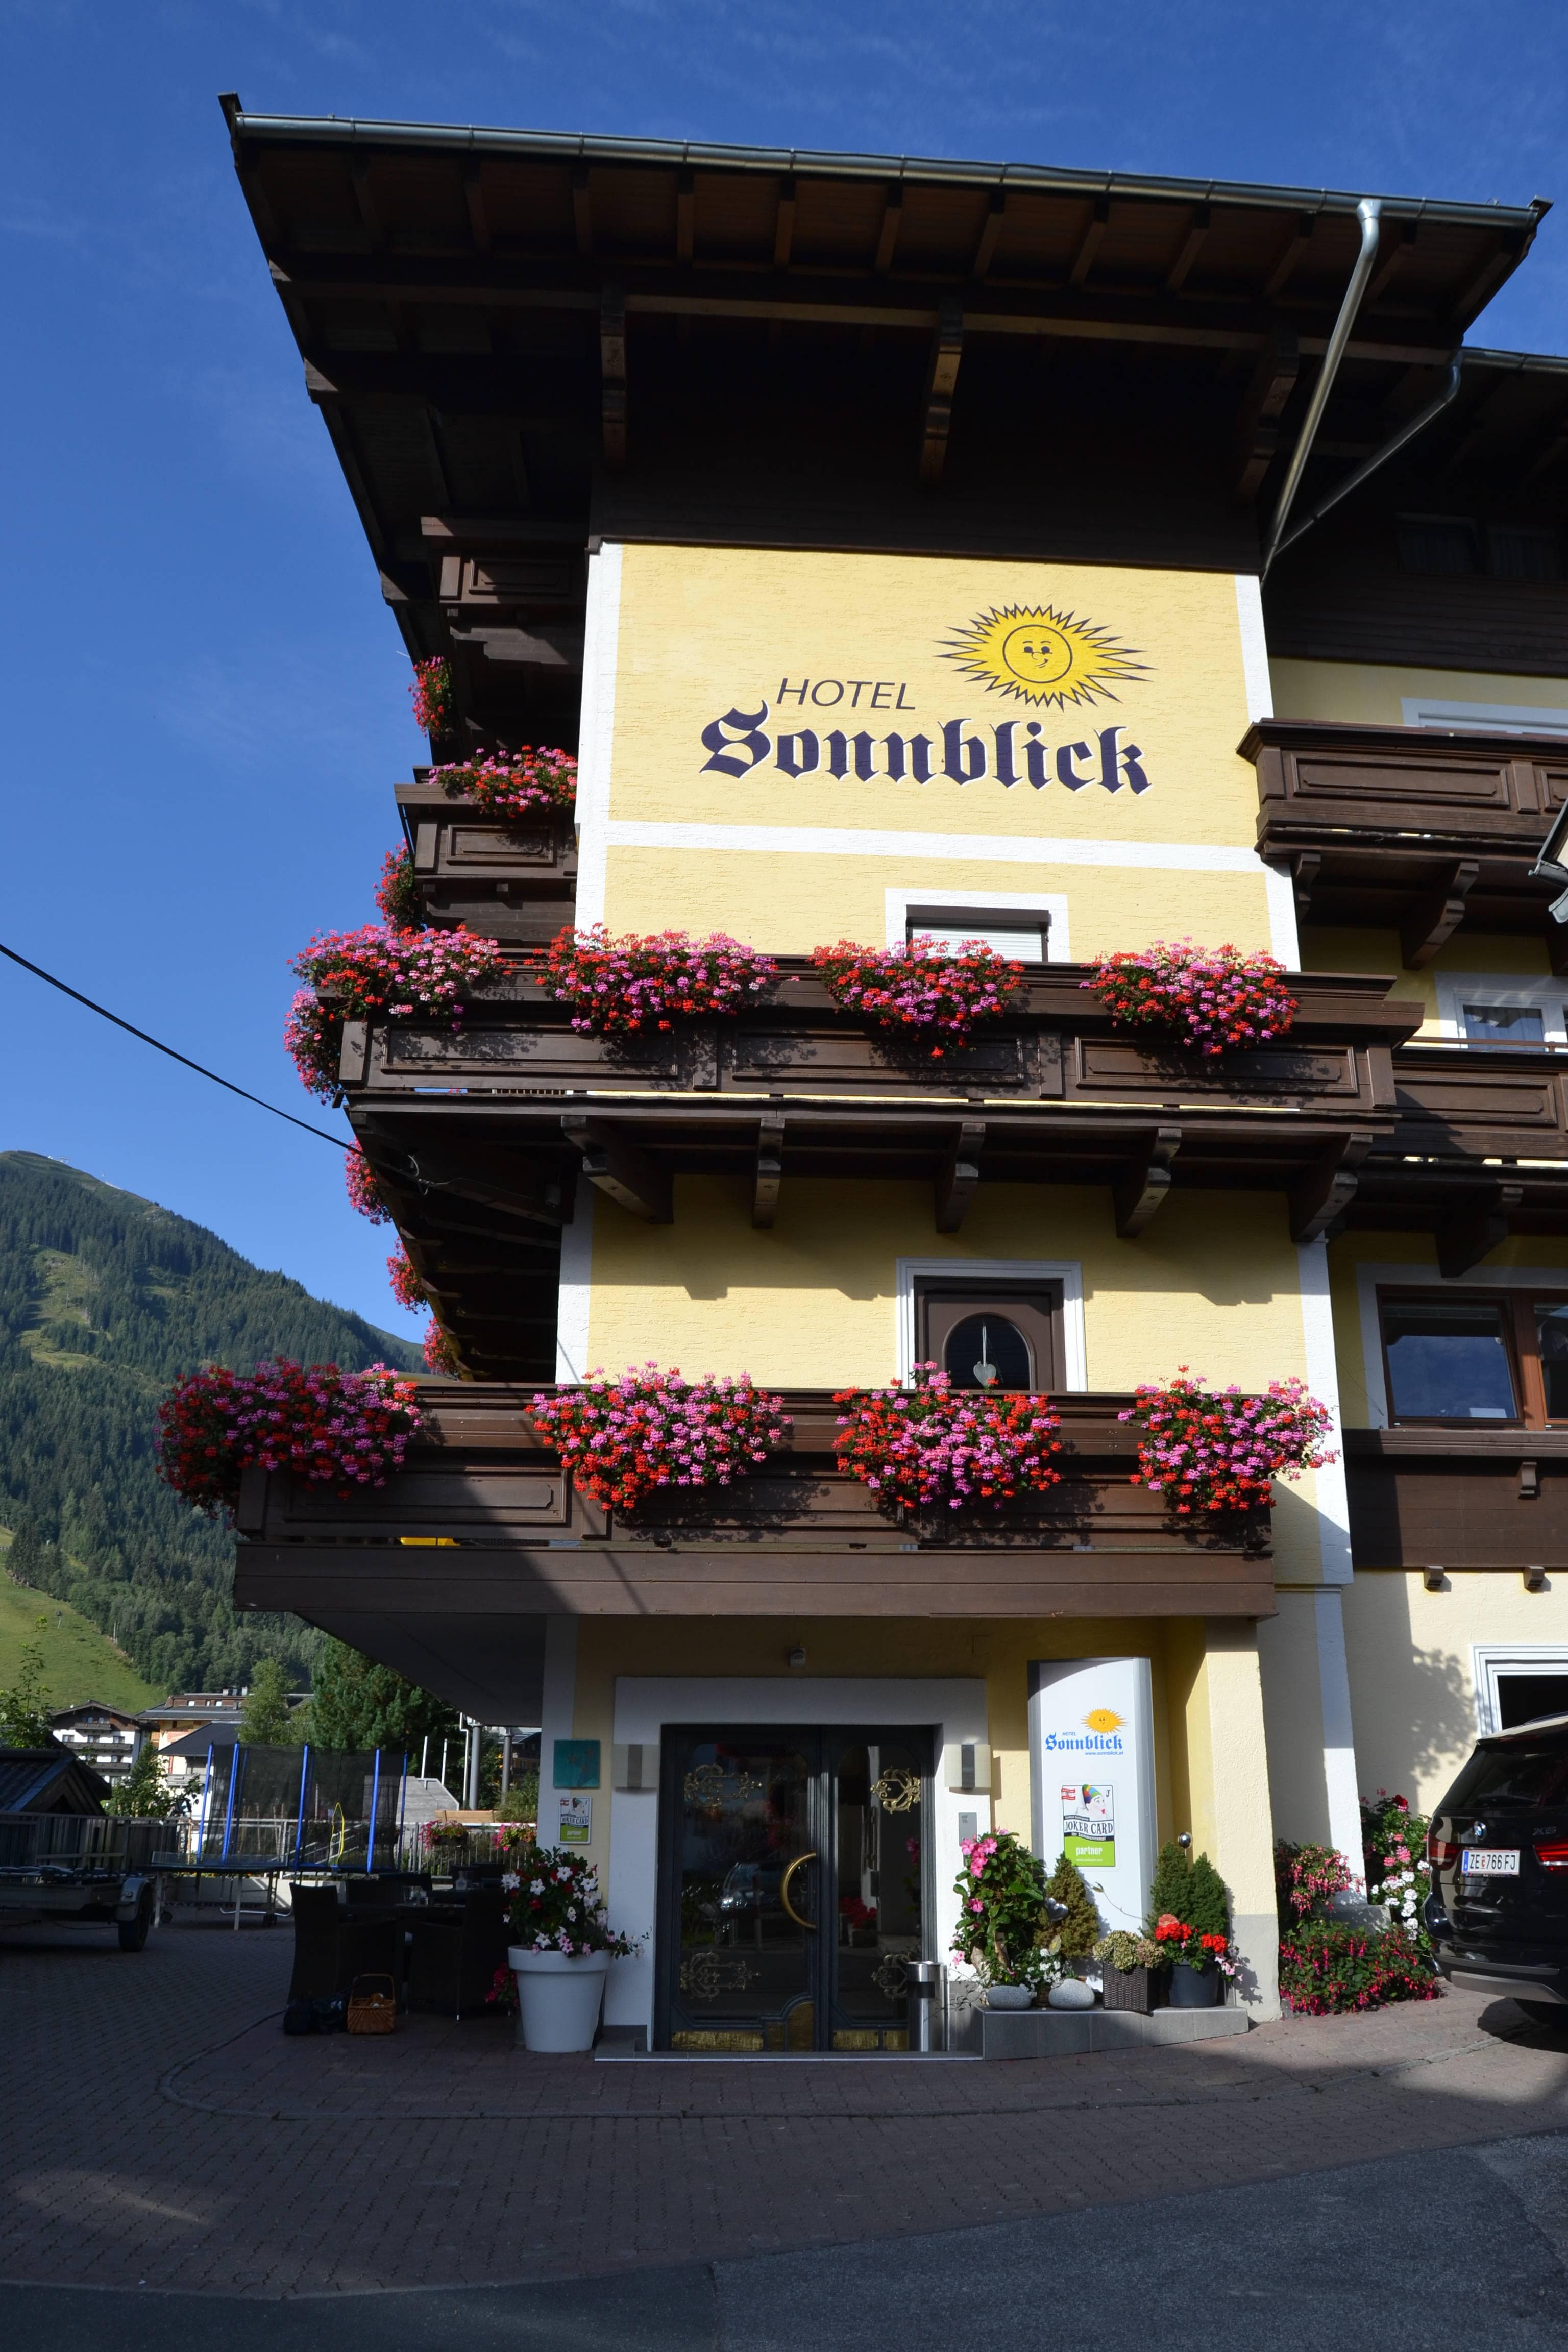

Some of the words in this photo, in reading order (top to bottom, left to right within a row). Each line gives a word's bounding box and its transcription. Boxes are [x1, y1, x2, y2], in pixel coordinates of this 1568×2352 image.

[776, 678, 916, 710] HOTEL
[699, 699, 1152, 796] Sonnblick
[1045, 1732, 1123, 1751] Sonnblick
[1065, 1821, 1088, 1834] JOKER
[1091, 1823, 1113, 1835] CARD
[1076, 1846, 1102, 1856] partner
[1470, 1854, 1480, 1869] ZE
[1486, 1854, 1503, 1870] 766
[1504, 1855, 1516, 1870] FJ
